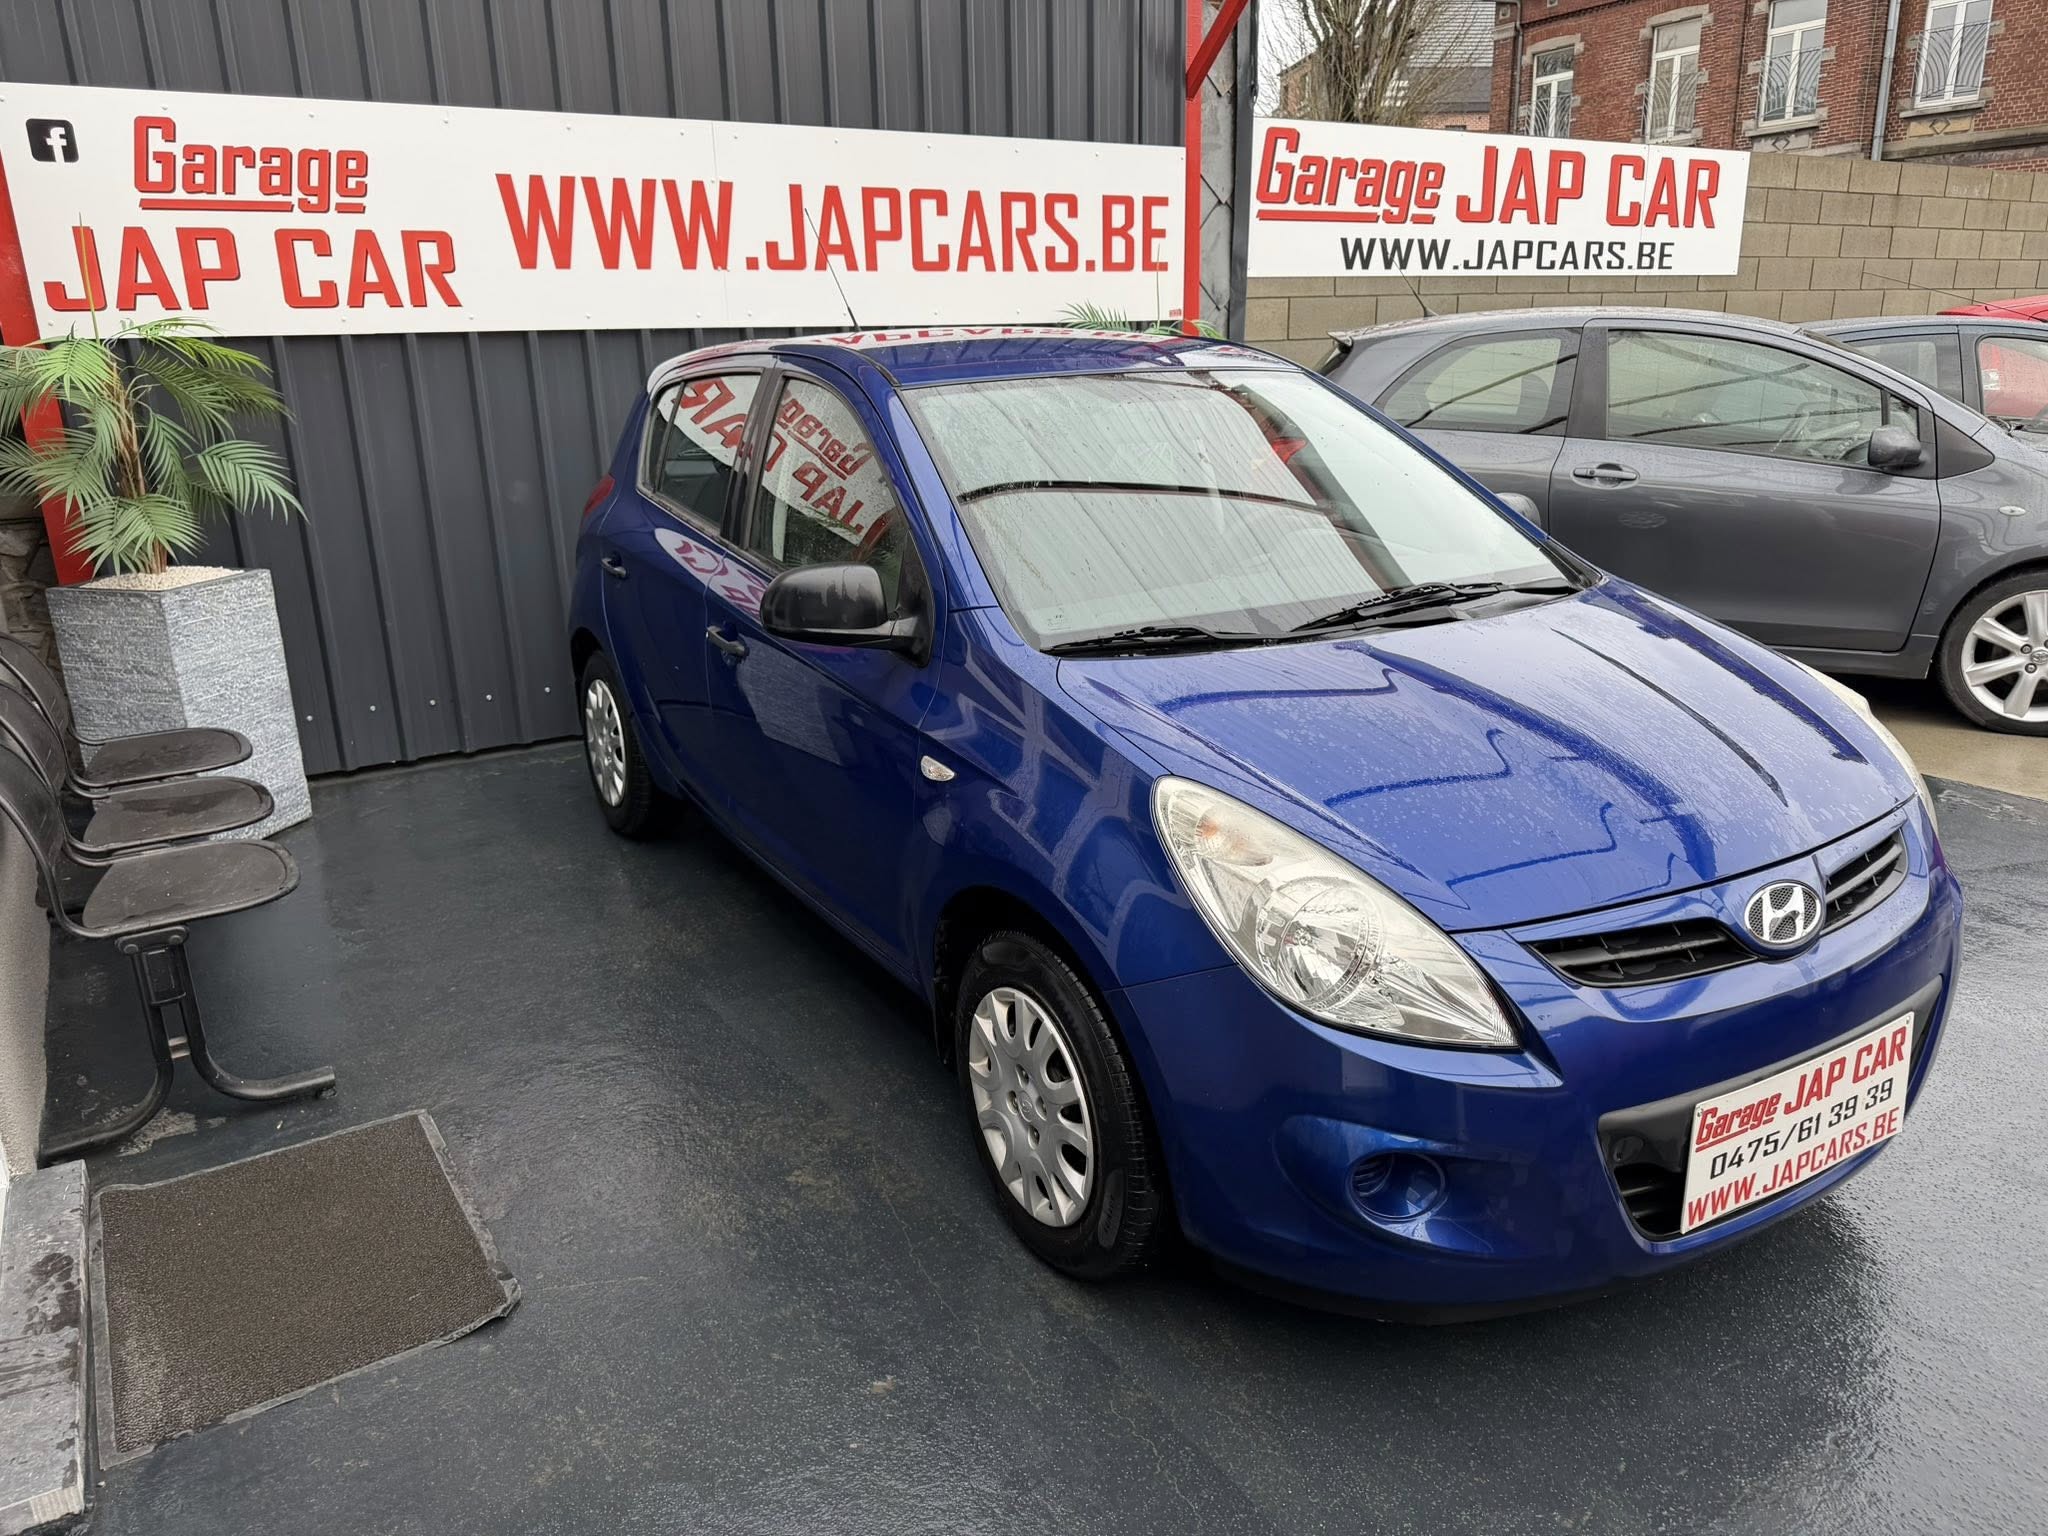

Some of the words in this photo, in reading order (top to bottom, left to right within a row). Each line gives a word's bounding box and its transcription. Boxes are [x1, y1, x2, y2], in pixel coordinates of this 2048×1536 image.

[134, 115, 369, 213] Garage
[1257, 127, 1445, 224] Garage
[1456, 146, 1586, 225] JAP
[1605, 154, 1721, 229] CAR
[43, 226, 241, 312] JAP
[274, 228, 462, 309] CAR
[495, 173, 1170, 273] WWW.JAPCARS.BE
[1340, 237, 1676, 271] WWW.JAPCARS.BE
[1695, 1092, 1782, 1146] Garage
[1783, 1056, 1847, 1116] JAP
[1851, 1026, 1907, 1084] CAR
[1710, 1112, 1822, 1180] 0475/61
[1828, 1094, 1859, 1128] 39
[1864, 1077, 1894, 1111] 39
[1687, 1106, 1900, 1227] WWW.JAPCARS.BE
